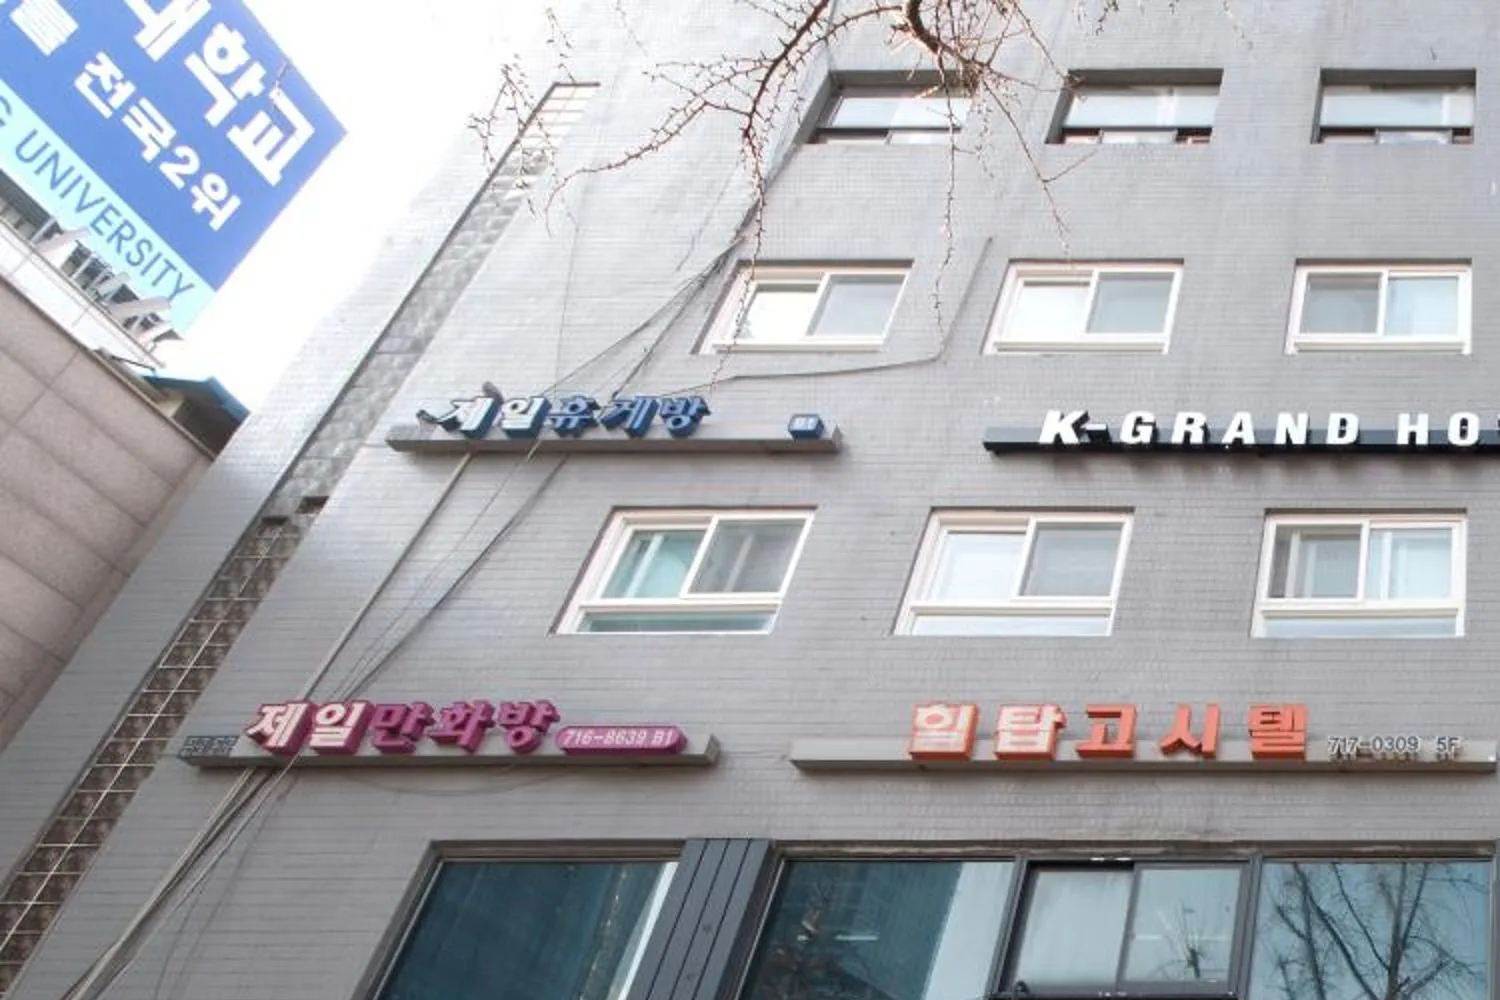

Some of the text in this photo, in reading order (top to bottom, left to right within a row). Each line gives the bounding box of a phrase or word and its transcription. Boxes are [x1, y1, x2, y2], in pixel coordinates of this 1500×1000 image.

[72, 51, 241, 231] 전국2위
[15, 129, 195, 301] UNIVERSITY
[1038, 410, 1360, 446] K-GRAND
[907, 703, 1310, 762] 힐탑고시텔
[1328, 736, 1419, 752] 717-0309
